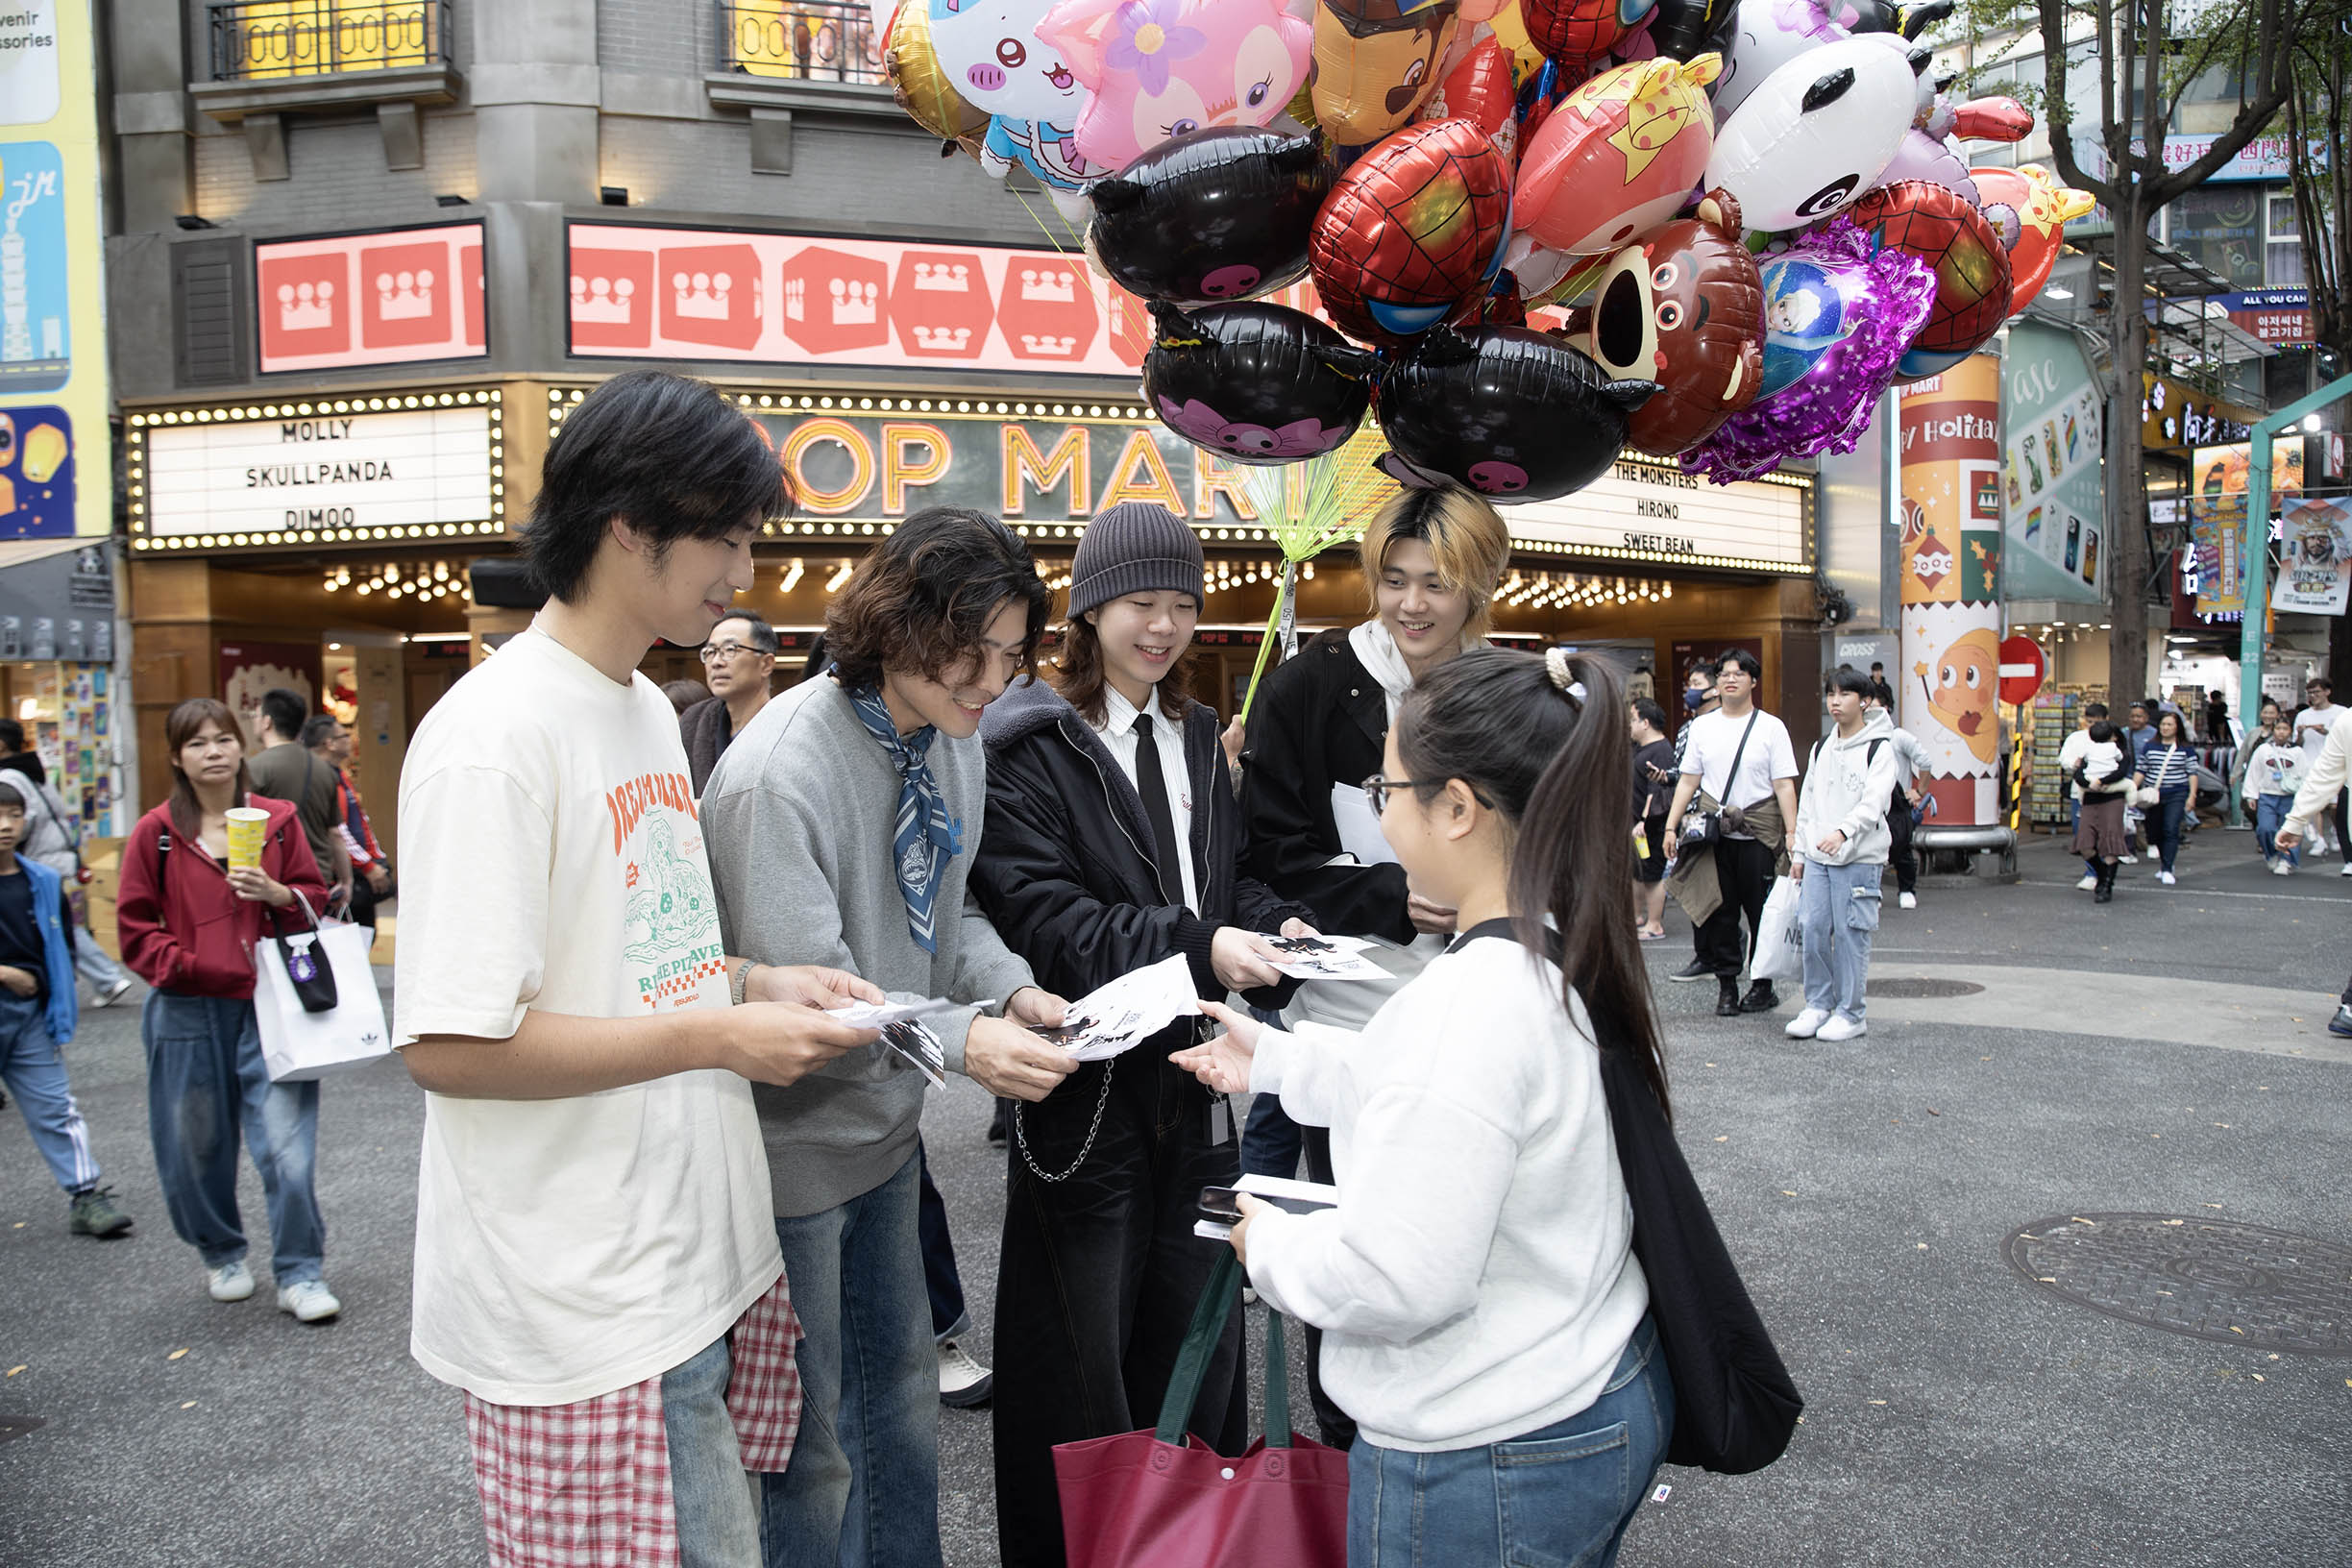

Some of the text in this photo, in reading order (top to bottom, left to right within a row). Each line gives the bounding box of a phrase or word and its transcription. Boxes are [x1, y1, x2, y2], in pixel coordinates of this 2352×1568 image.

[2242, 293, 2308, 306] ALL YOU CAN
[282, 419, 354, 443] MOLLY
[247, 460, 393, 488] SKULLPANDA
[753, 417, 953, 516] OP
[1614, 462, 1699, 490] THE MONSTERS
[285, 507, 355, 529] DIMOO
[1637, 500, 1679, 520] HIRONO
[1624, 532, 1695, 554] SWEET BEAN
[2246, 630, 2256, 642] E
[1839, 642, 1876, 657] CROSS
[2243, 652, 2259, 663] 22
